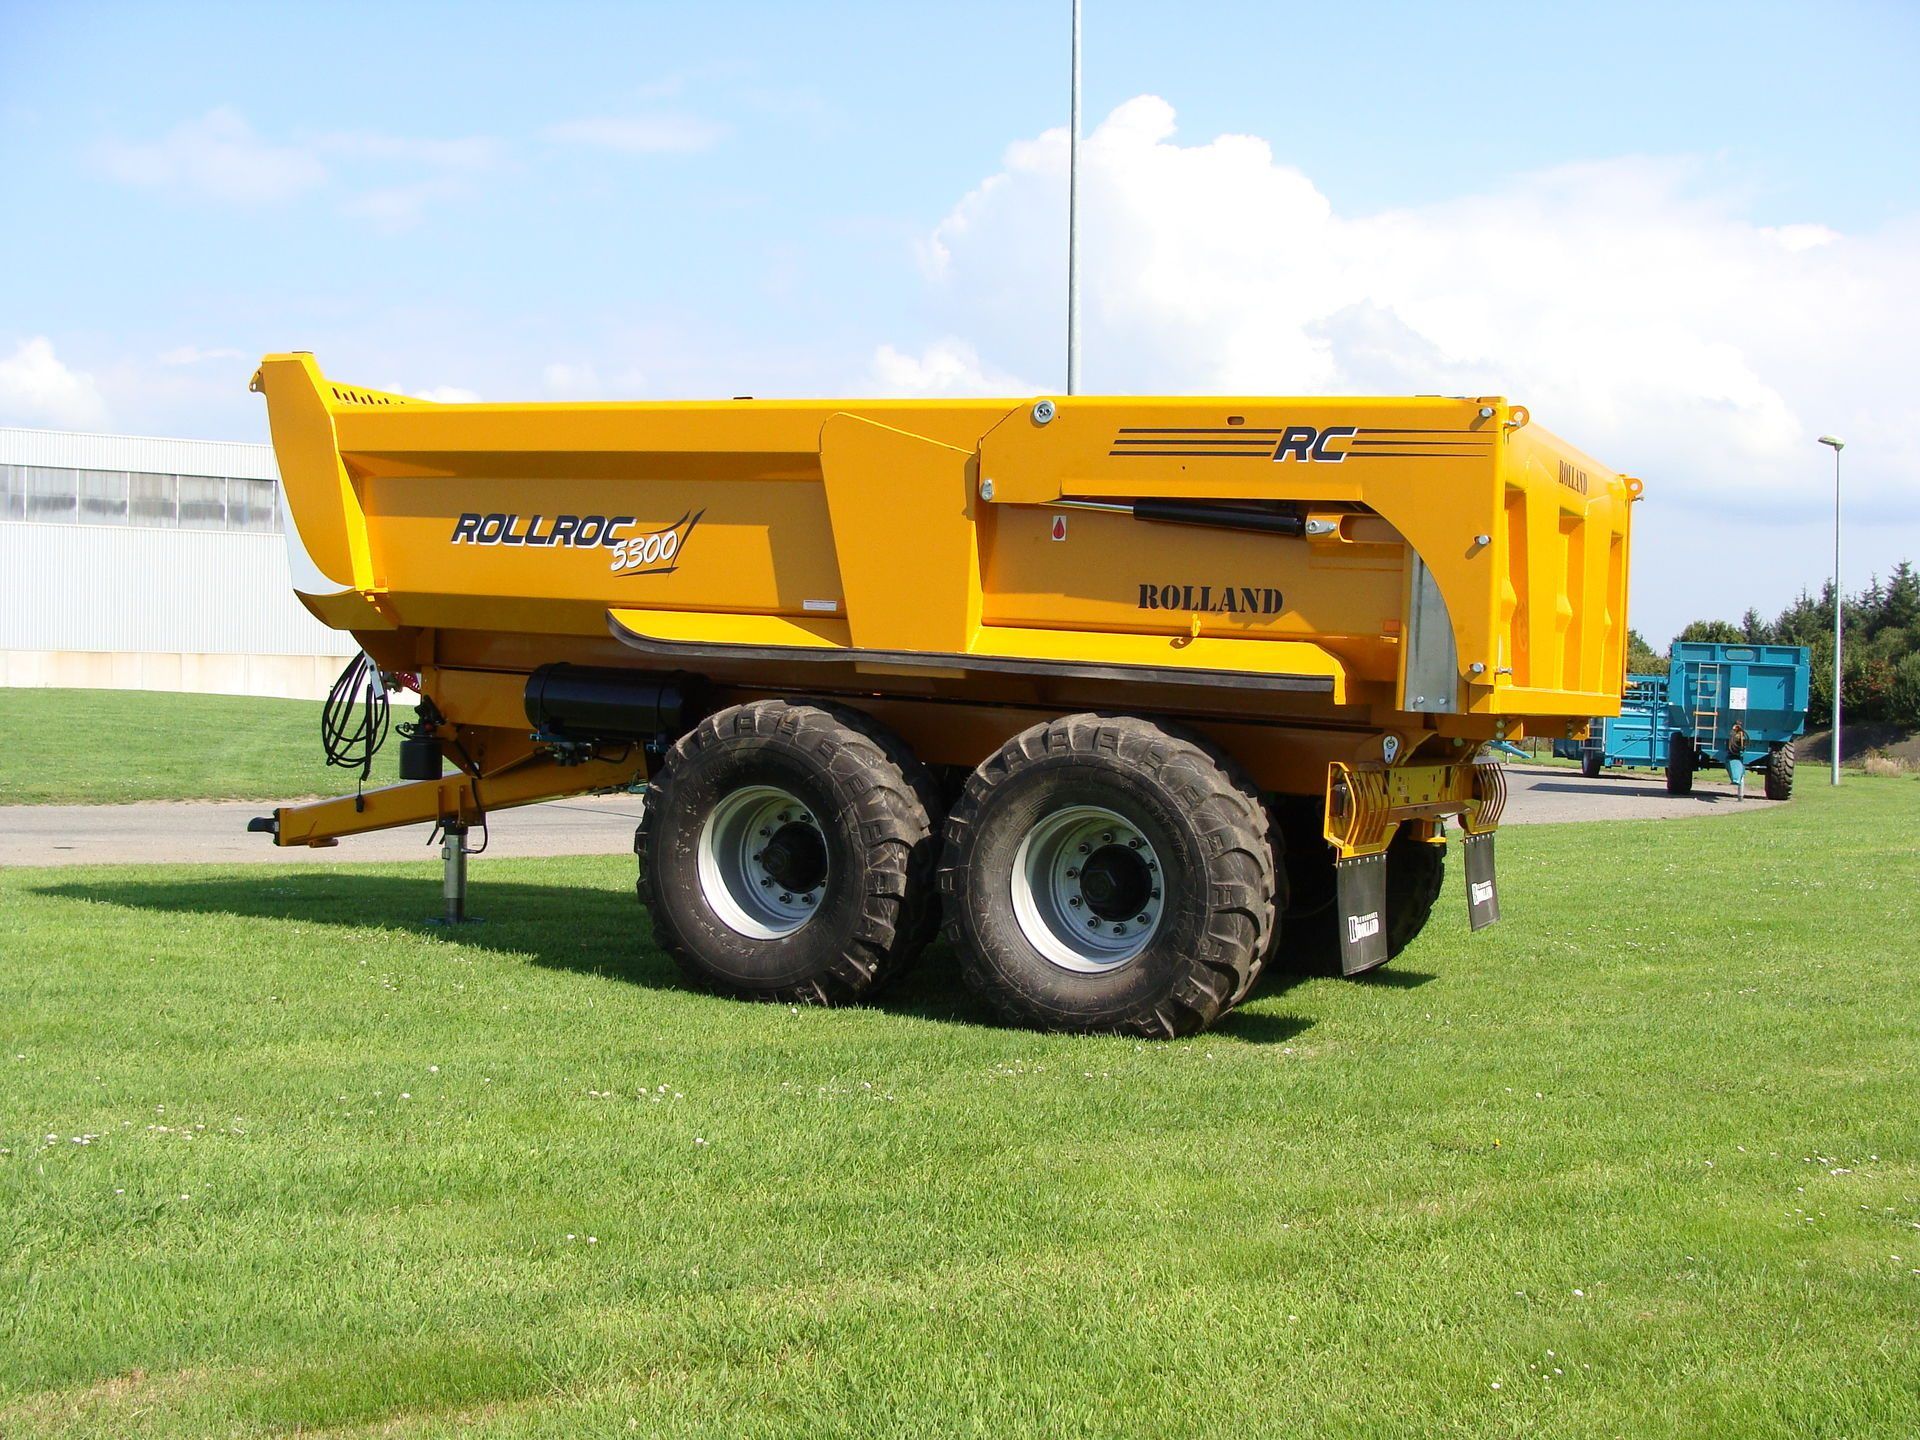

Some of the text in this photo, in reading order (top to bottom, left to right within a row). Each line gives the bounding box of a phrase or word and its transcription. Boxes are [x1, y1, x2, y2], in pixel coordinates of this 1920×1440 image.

[1273, 426, 1357, 462] RC
[1559, 460, 1588, 495] ROLLAND
[451, 513, 637, 549] ROLLROC
[610, 530, 679, 572] 5300
[1138, 584, 1283, 614] ROLLAND
